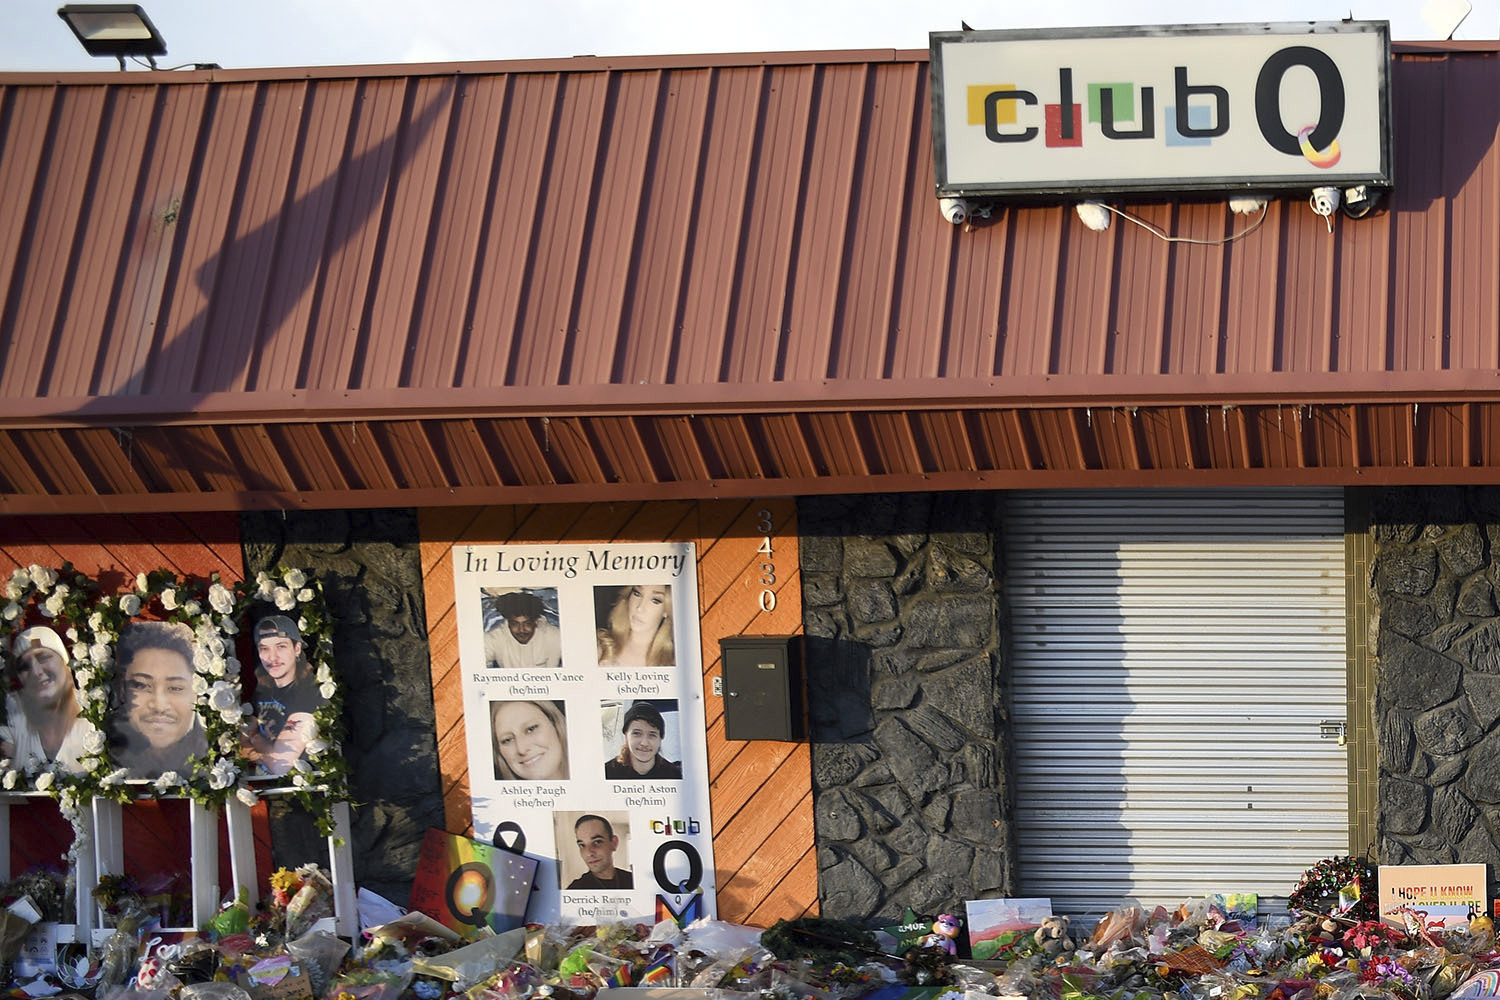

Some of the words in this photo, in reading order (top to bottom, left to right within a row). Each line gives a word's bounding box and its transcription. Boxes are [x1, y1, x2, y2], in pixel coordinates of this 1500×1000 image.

[984, 66, 1229, 142] club
[1255, 45, 1346, 169] Q
[465, 551, 487, 573] In
[496, 551, 579, 578] Loving
[585, 550, 687, 577] Memory
[757, 510, 776, 612] 3430
[473, 673, 519, 685] Raymond
[522, 674, 551, 682] Green
[555, 673, 584, 682] Vance
[607, 673, 632, 685] Kelly
[636, 673, 670, 683] Loving
[510, 685, 549, 695] (he/him)
[618, 684, 659, 694] (she/her)
[501, 786, 533, 797] Ashley
[537, 786, 566, 796] Paugh
[613, 785, 646, 794] Daniel
[649, 785, 677, 794] Aston
[514, 798, 554, 808] (she/her)
[626, 797, 666, 807] (he/him)
[653, 816, 700, 835] club
[653, 841, 704, 896] Q
[1399, 887, 1427, 900] HOPE
[1430, 887, 1437, 900] U
[1441, 886, 1473, 899] KNOW
[563, 895, 600, 904] Derrick
[602, 896, 632, 906] Rump
[578, 907, 618, 917] (he/him)
